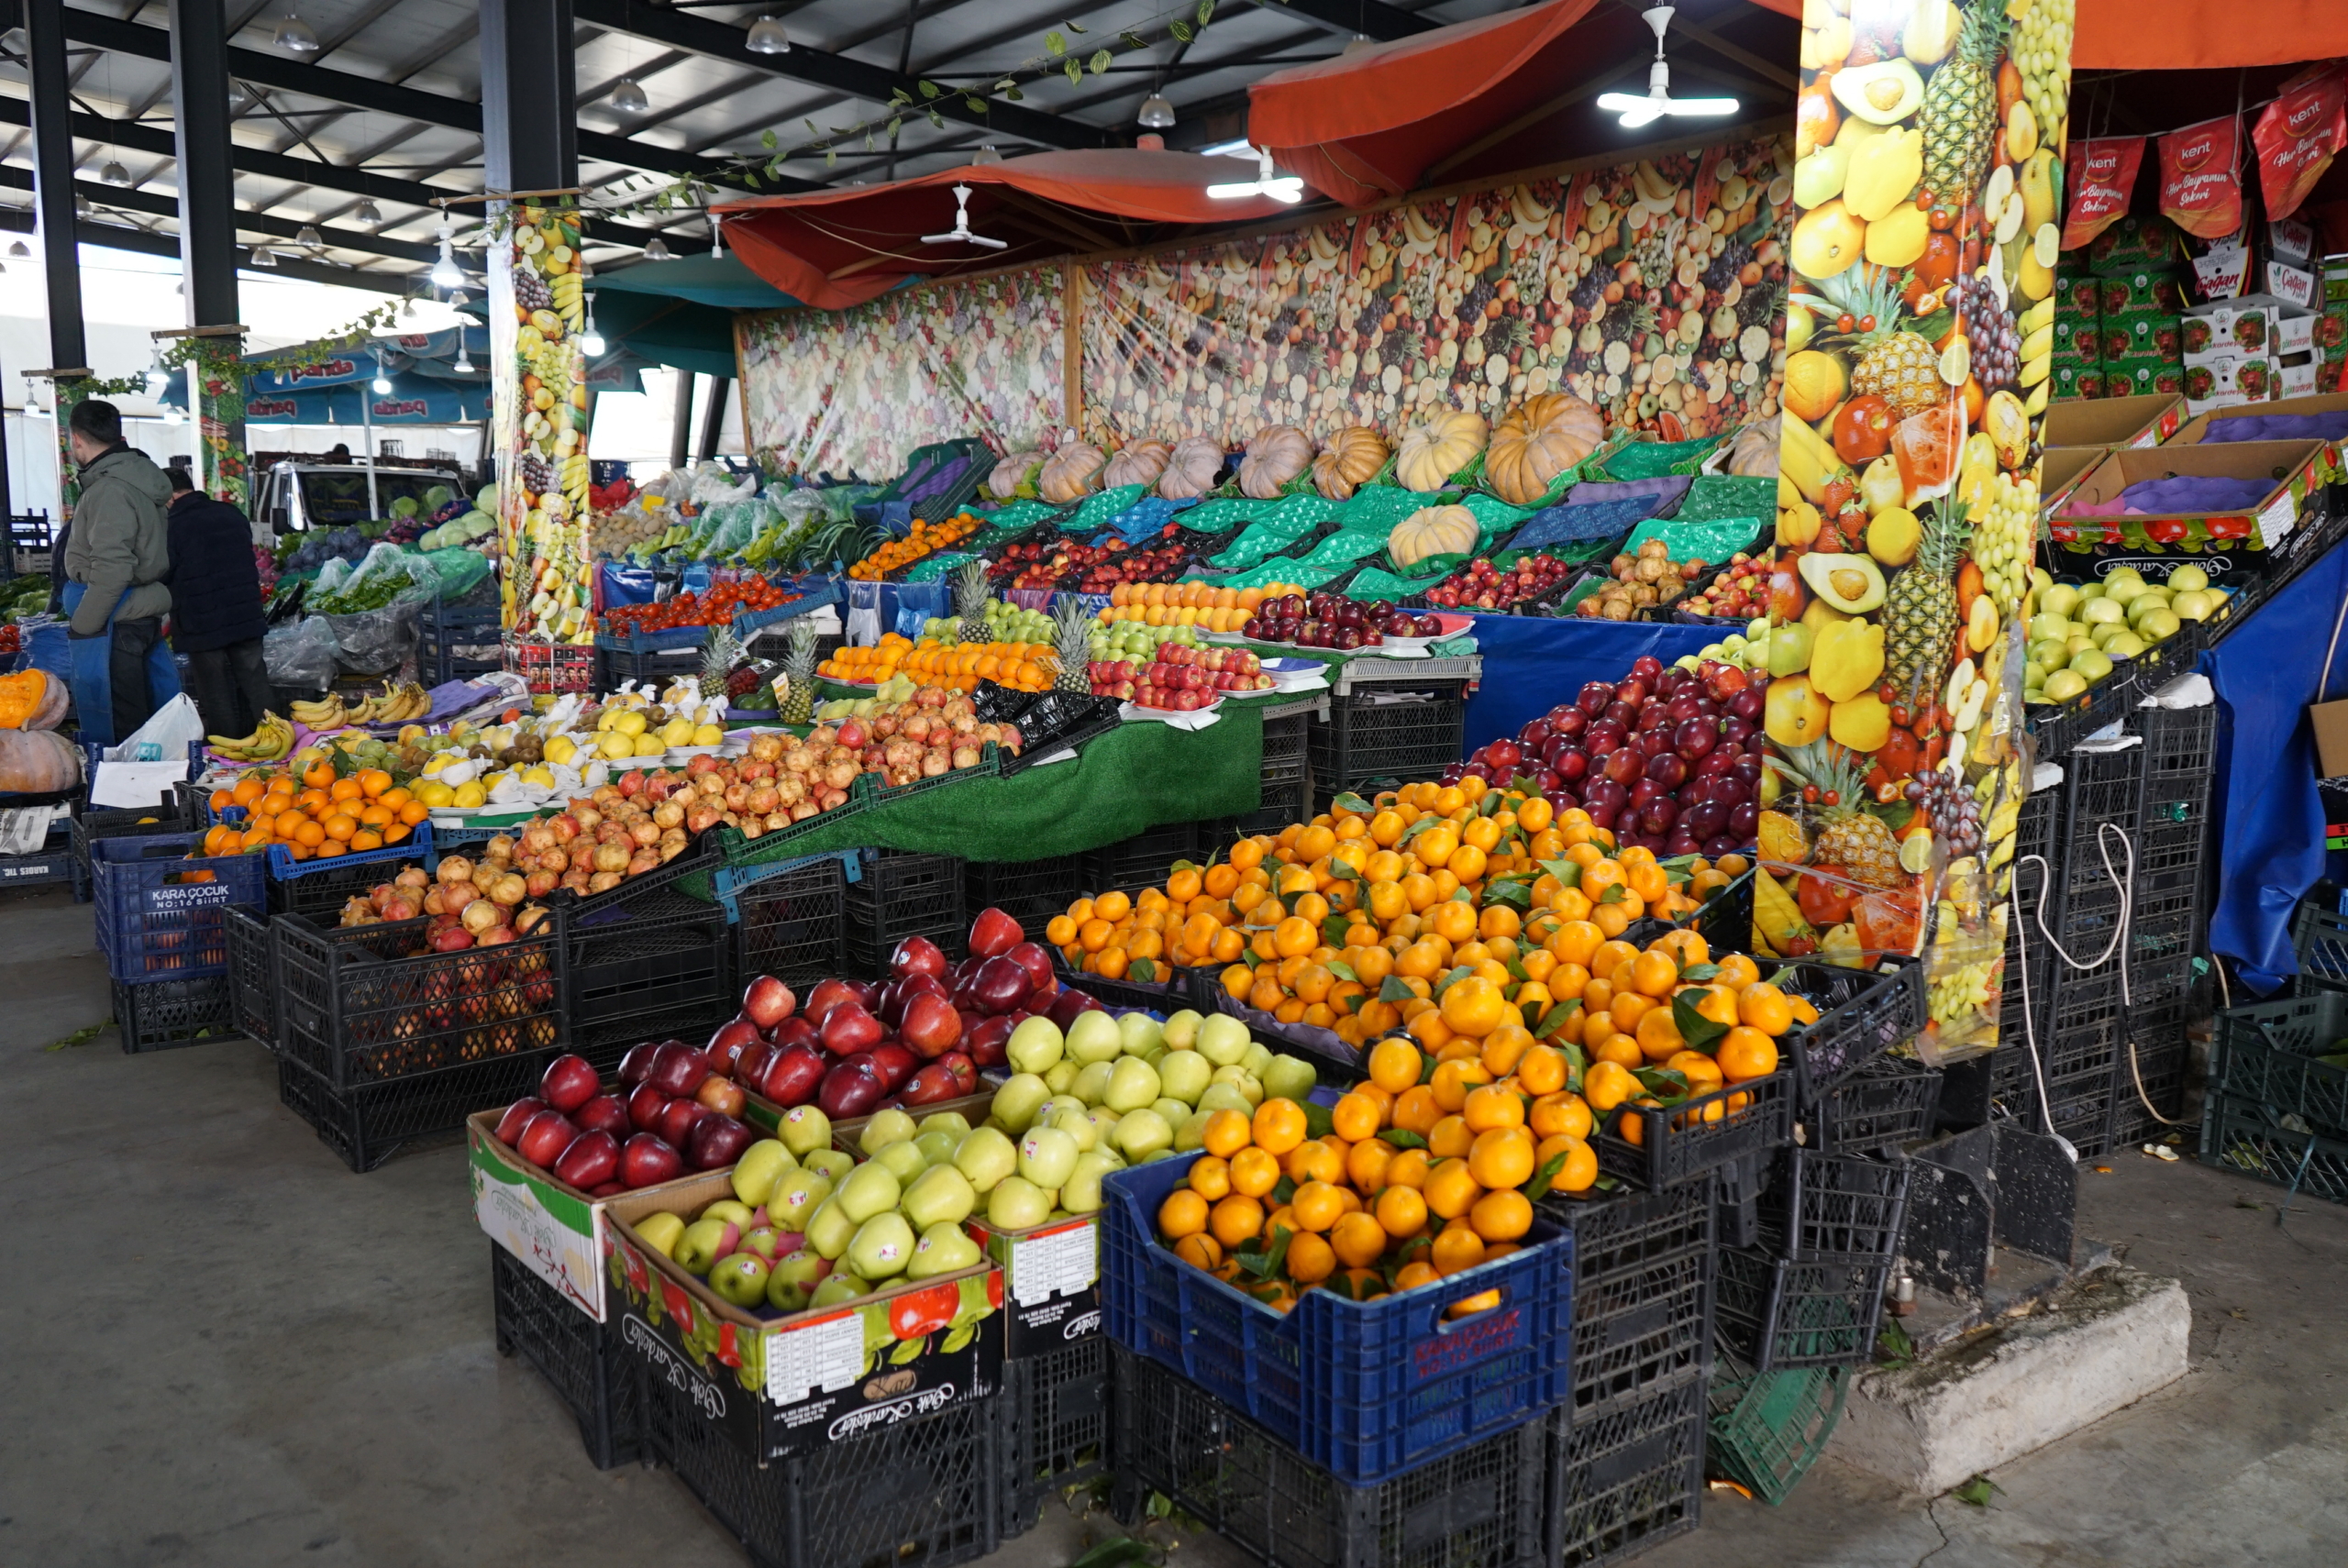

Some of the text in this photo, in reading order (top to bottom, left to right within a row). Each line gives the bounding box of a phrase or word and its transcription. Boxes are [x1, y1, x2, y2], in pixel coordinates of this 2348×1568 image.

[2288, 101, 2320, 127] kent
[2182, 141, 2210, 160] kent
[2273, 150, 2296, 167] Her
[2165, 173, 2229, 197] Her Bayramın
[2179, 188, 2210, 207] Şekeri
[290, 359, 354, 383] panda
[152, 885, 229, 900] KARA ÇOCUK
[1066, 1283, 1084, 1291] VARIETY
[1414, 1332, 1462, 1364] KARA
[628, 1322, 726, 1419] Gök Kardeşler
[827, 1377, 850, 1387] VARIETY
[916, 1383, 954, 1414] Gök
[836, 1401, 912, 1438] Kardeşler
